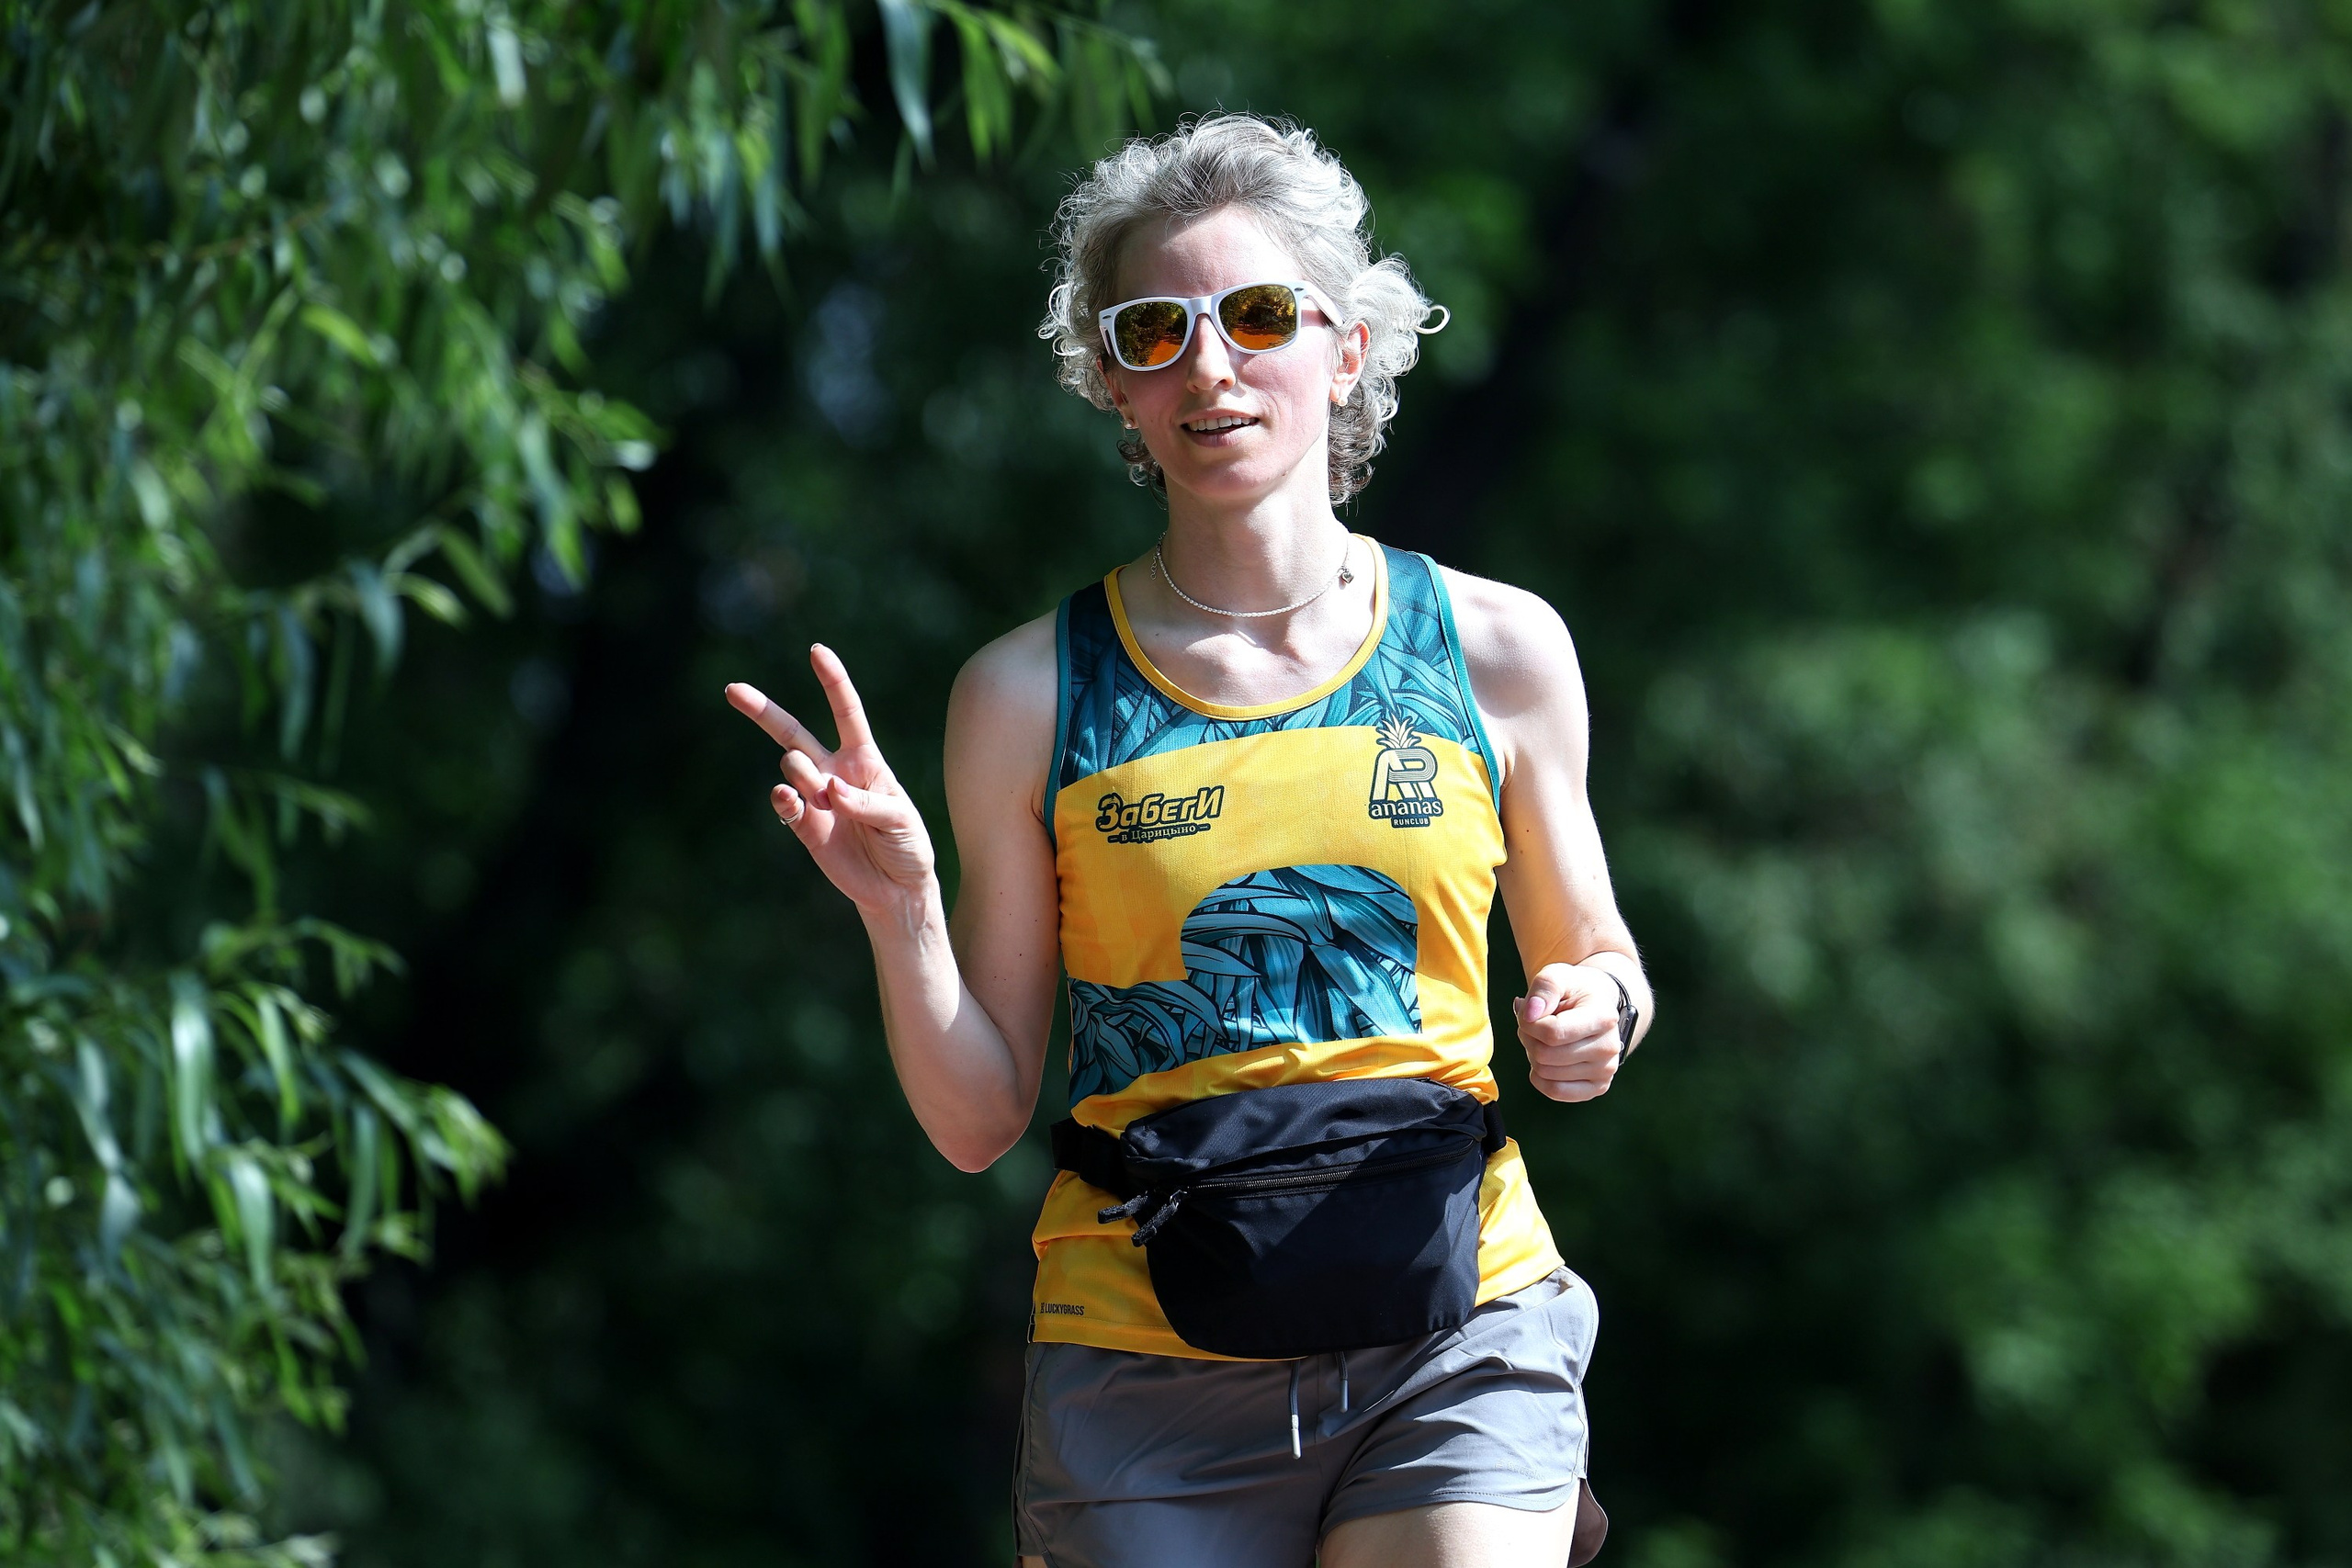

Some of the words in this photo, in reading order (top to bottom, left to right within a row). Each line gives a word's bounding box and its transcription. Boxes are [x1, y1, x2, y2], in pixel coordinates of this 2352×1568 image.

[1371, 800, 1442, 817] ananas
[1393, 818, 1430, 826] RUNCLUB
[1131, 825, 1196, 841] Царицыно
[1046, 1303, 1085, 1316] LUCKYGRASS
